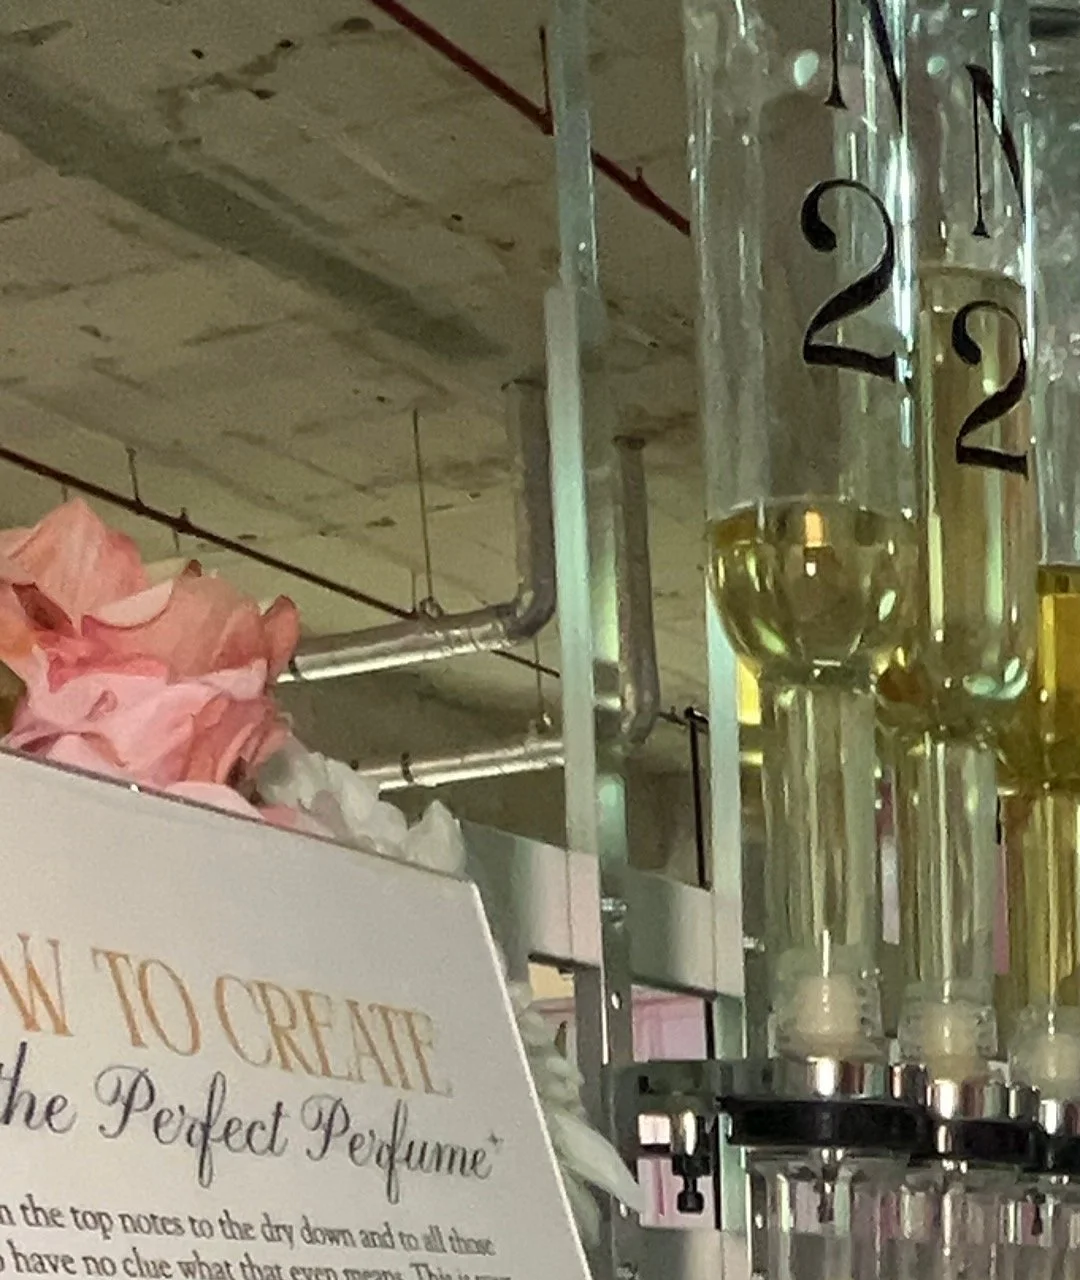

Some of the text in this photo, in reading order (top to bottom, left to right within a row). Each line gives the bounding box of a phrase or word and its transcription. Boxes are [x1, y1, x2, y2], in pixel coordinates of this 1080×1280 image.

[90, 947, 201, 1056] TO
[213, 973, 455, 1099] CREATE
[0, 1041, 494, 1204] the Perfect Perfume
[7, 1239, 78, 1277] have
[83, 1254, 118, 1277] no
[123, 1247, 174, 1279] clue
[20, 1194, 65, 1229] the
[70, 1206, 114, 1241] top
[118, 1210, 186, 1237] notes
[189, 1215, 215, 1240] to
[219, 1209, 257, 1242] the
[261, 1212, 295, 1250] dry
[300, 1215, 357, 1248] down
[359, 1221, 396, 1250] and
[399, 1230, 420, 1252] to
